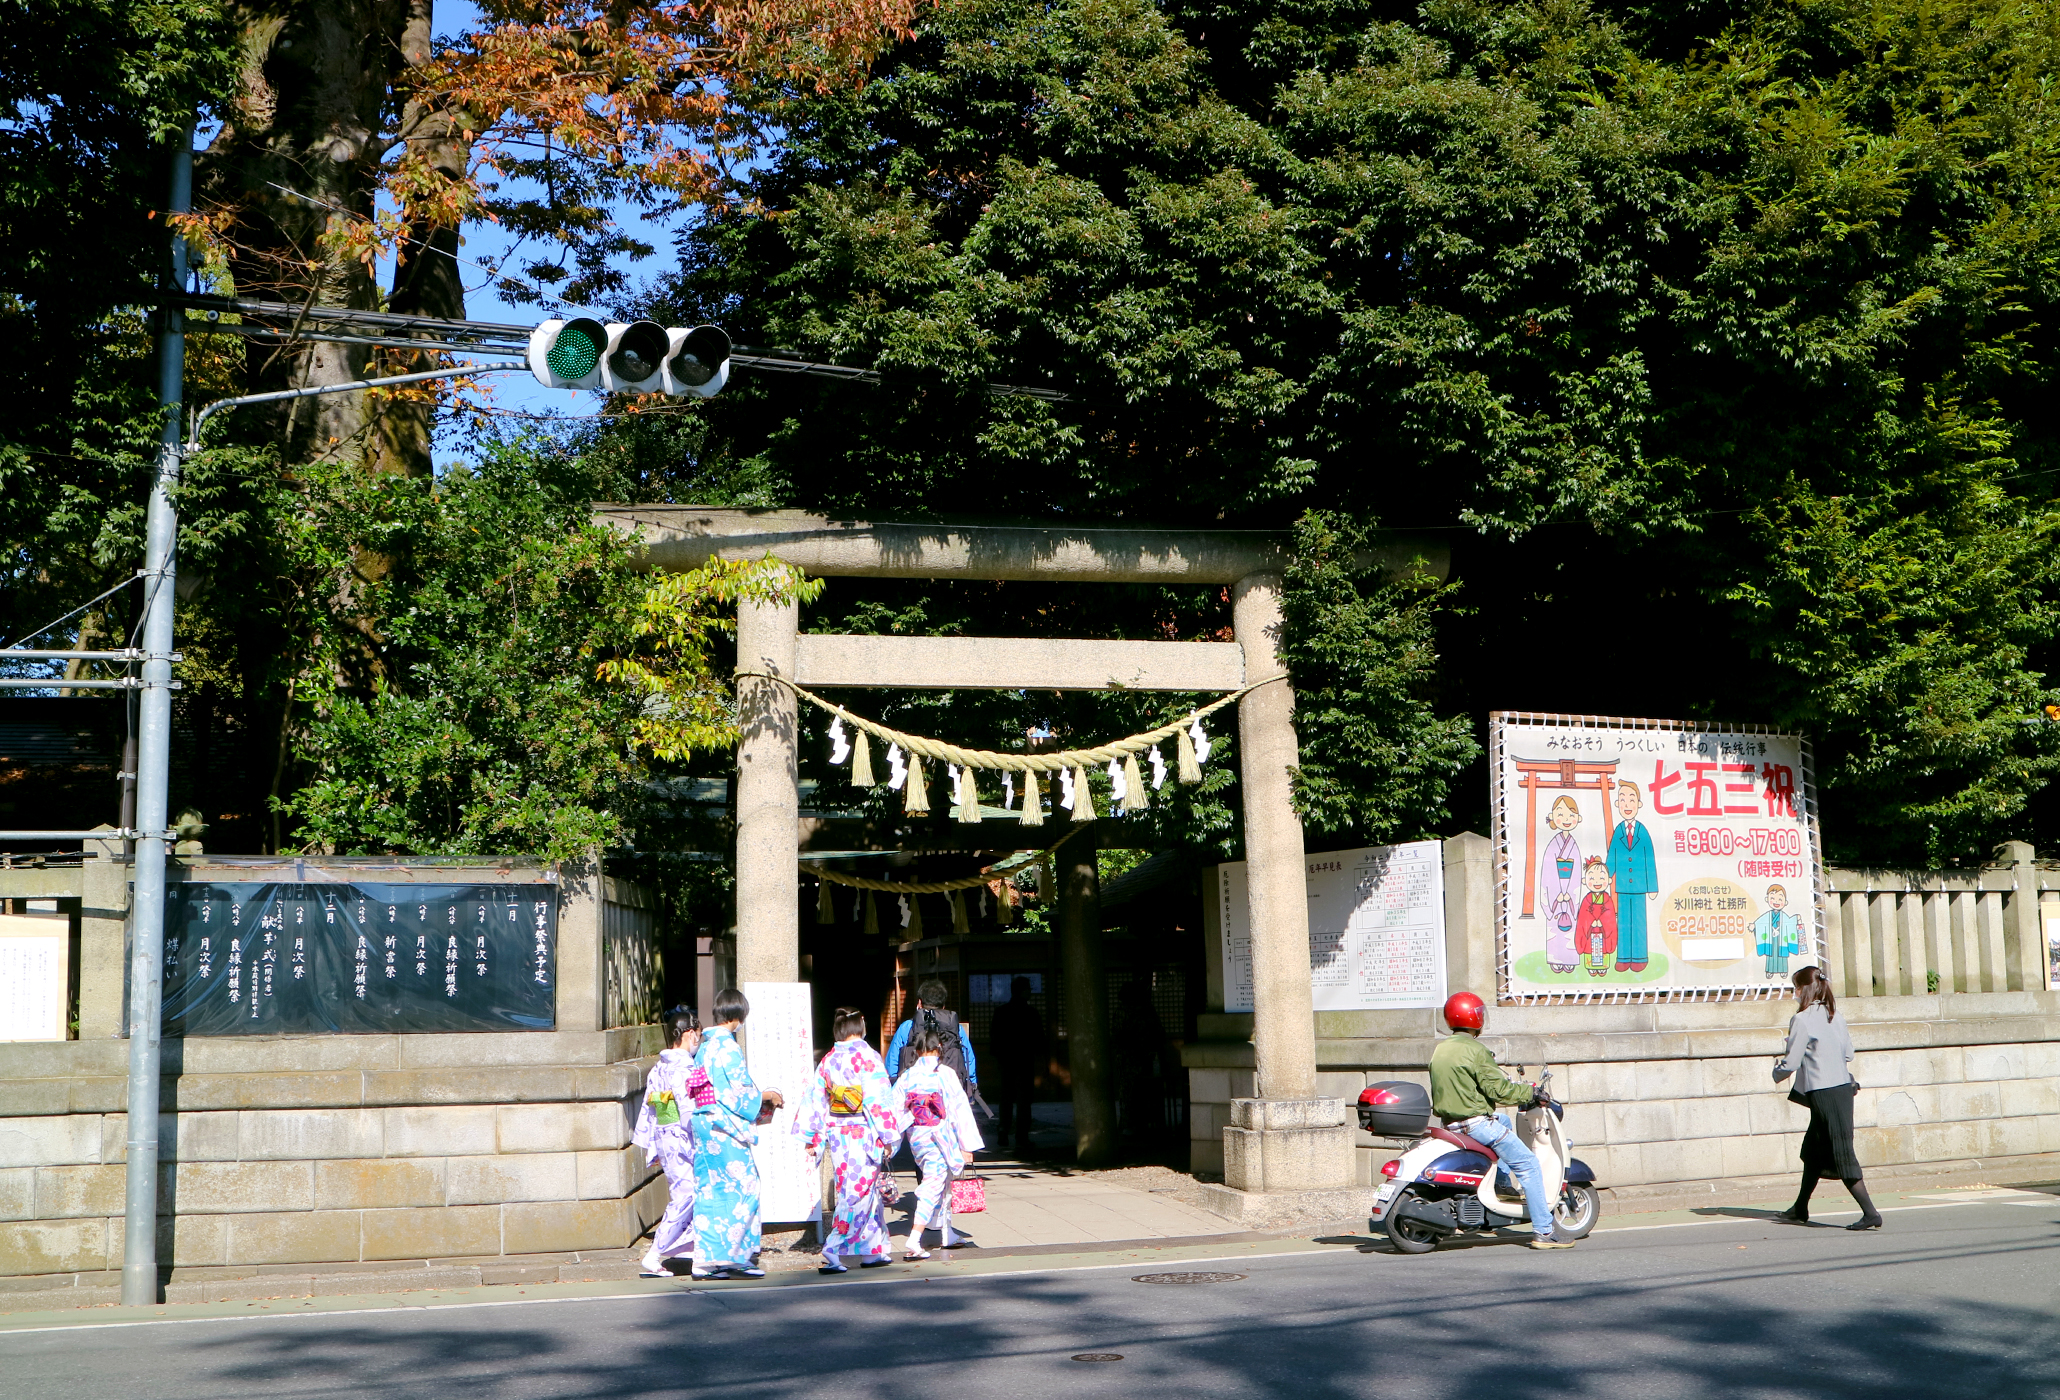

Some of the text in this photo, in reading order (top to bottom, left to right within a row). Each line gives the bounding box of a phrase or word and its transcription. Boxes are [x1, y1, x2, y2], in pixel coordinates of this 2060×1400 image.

[1547, 736, 1767, 757] みなおそう うつくしい 日本の 伝統行事
[1648, 759, 1798, 819] 七五三祝
[1674, 830, 1686, 853] 毎日
[325, 891, 337, 924] 十二月
[507, 892, 519, 922] 十一月
[1674, 897, 1747, 911] 氷川神社 社務所
[534, 902, 548, 983] 行事祭典予定
[1679, 914, 1745, 936] 224-0589
[166, 938, 179, 979] 煤払い
[199, 937, 212, 979] 月次祭
[228, 938, 243, 1003] 良縁祈願祭
[292, 937, 305, 980] 月次祭
[354, 936, 368, 998] 良縁祈願祭
[415, 935, 427, 976] 月次祭
[445, 935, 459, 997] 良縁祈願祭
[475, 936, 488, 977] 月次祭
